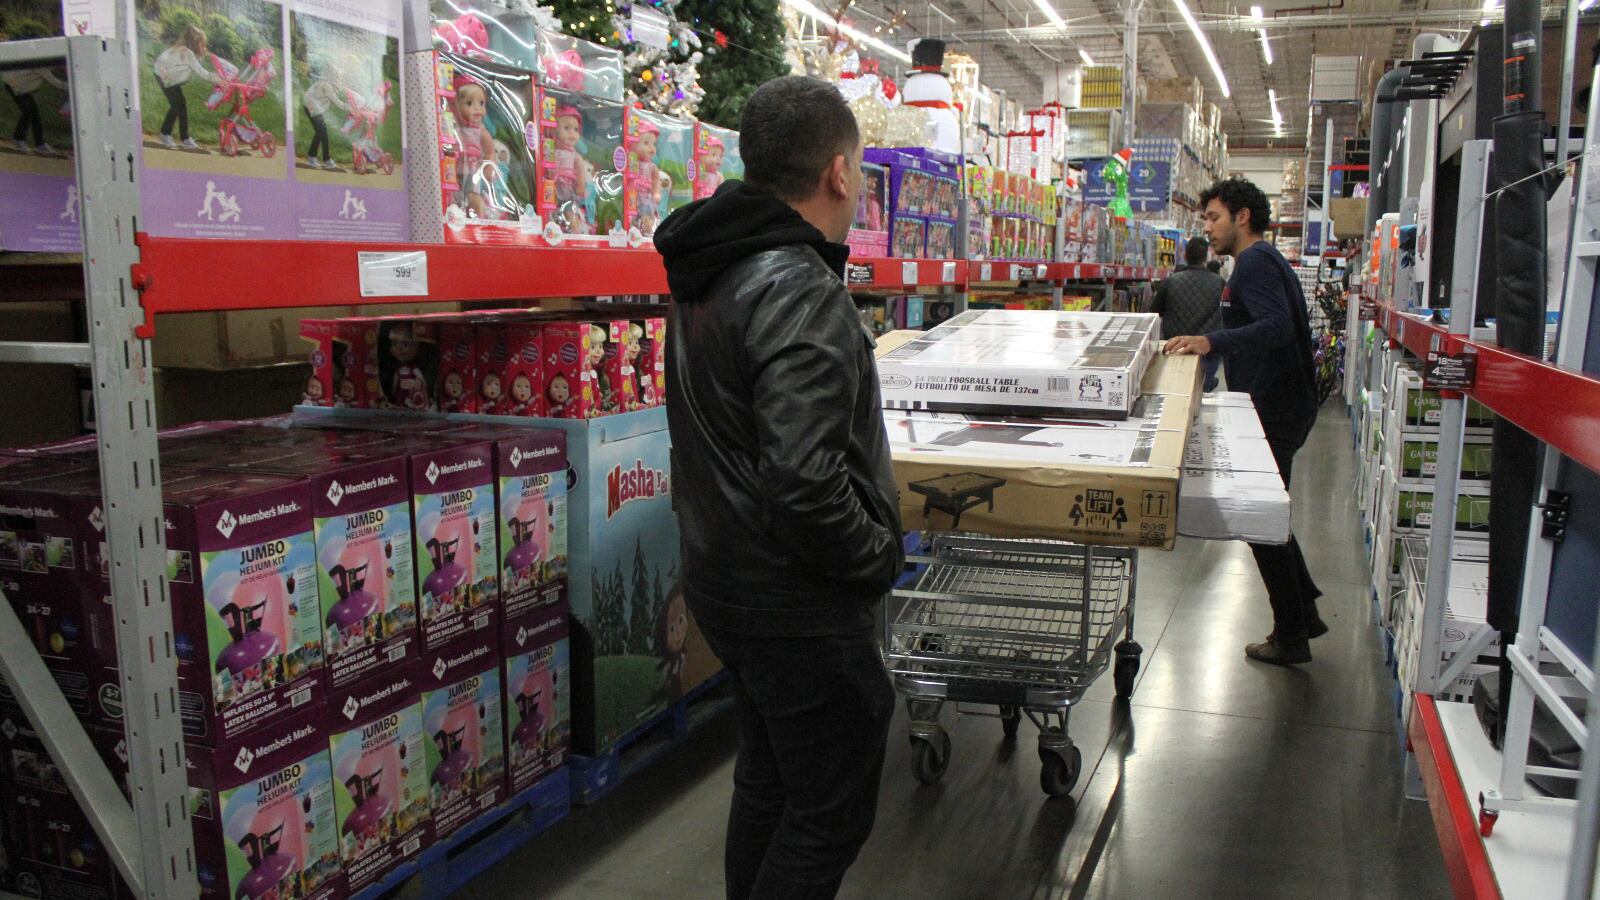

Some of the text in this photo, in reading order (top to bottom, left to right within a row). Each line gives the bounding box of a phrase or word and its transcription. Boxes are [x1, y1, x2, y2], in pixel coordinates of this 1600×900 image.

[914, 382, 958, 391] FUTBOLITO
[961, 384, 971, 392] DE
[974, 385, 997, 393] MESA
[1014, 386, 1039, 395] 137cm
[927, 375, 947, 384] INCH
[950, 376, 991, 385] FOOSBALL
[993, 378, 1020, 386] TABLE
[545, 446, 558, 455] Mark
[468, 457, 482, 468] Mark
[377, 474, 395, 486] Mark
[521, 474, 549, 489] JUMBO
[440, 489, 472, 508] JUMBO
[606, 459, 655, 520] Masha
[1087, 489, 1113, 500] TEAM
[277, 501, 298, 515] Mark
[440, 502, 472, 516] HELIUM KIT
[1087, 499, 1112, 512] LIFT
[346, 509, 384, 531] JUMBO
[345, 523, 384, 540] HELIUM KIT
[239, 540, 285, 565] JUMBO
[239, 555, 286, 577] HELIUM KIT
[474, 645, 489, 656] Mark
[528, 645, 553, 665] JUMBO
[332, 654, 357, 670] INFLATES
[356, 652, 364, 660] 50
[332, 655, 377, 679] LATEX BALLOONS
[391, 678, 409, 692] Mark
[448, 677, 479, 700] JUMBO
[223, 701, 253, 720] INFLATES
[253, 697, 262, 707] 50
[262, 695, 268, 703] X
[224, 713, 246, 729] LATEX
[245, 701, 278, 720] BALLOONS
[292, 724, 313, 741] Mark
[361, 714, 398, 741] JUMBO
[361, 726, 399, 751] HELIUM KIT
[257, 764, 301, 796] JUMBO
[257, 778, 301, 806] HELIUM KIT
[348, 852, 392, 883] LATEX BALLOONS
